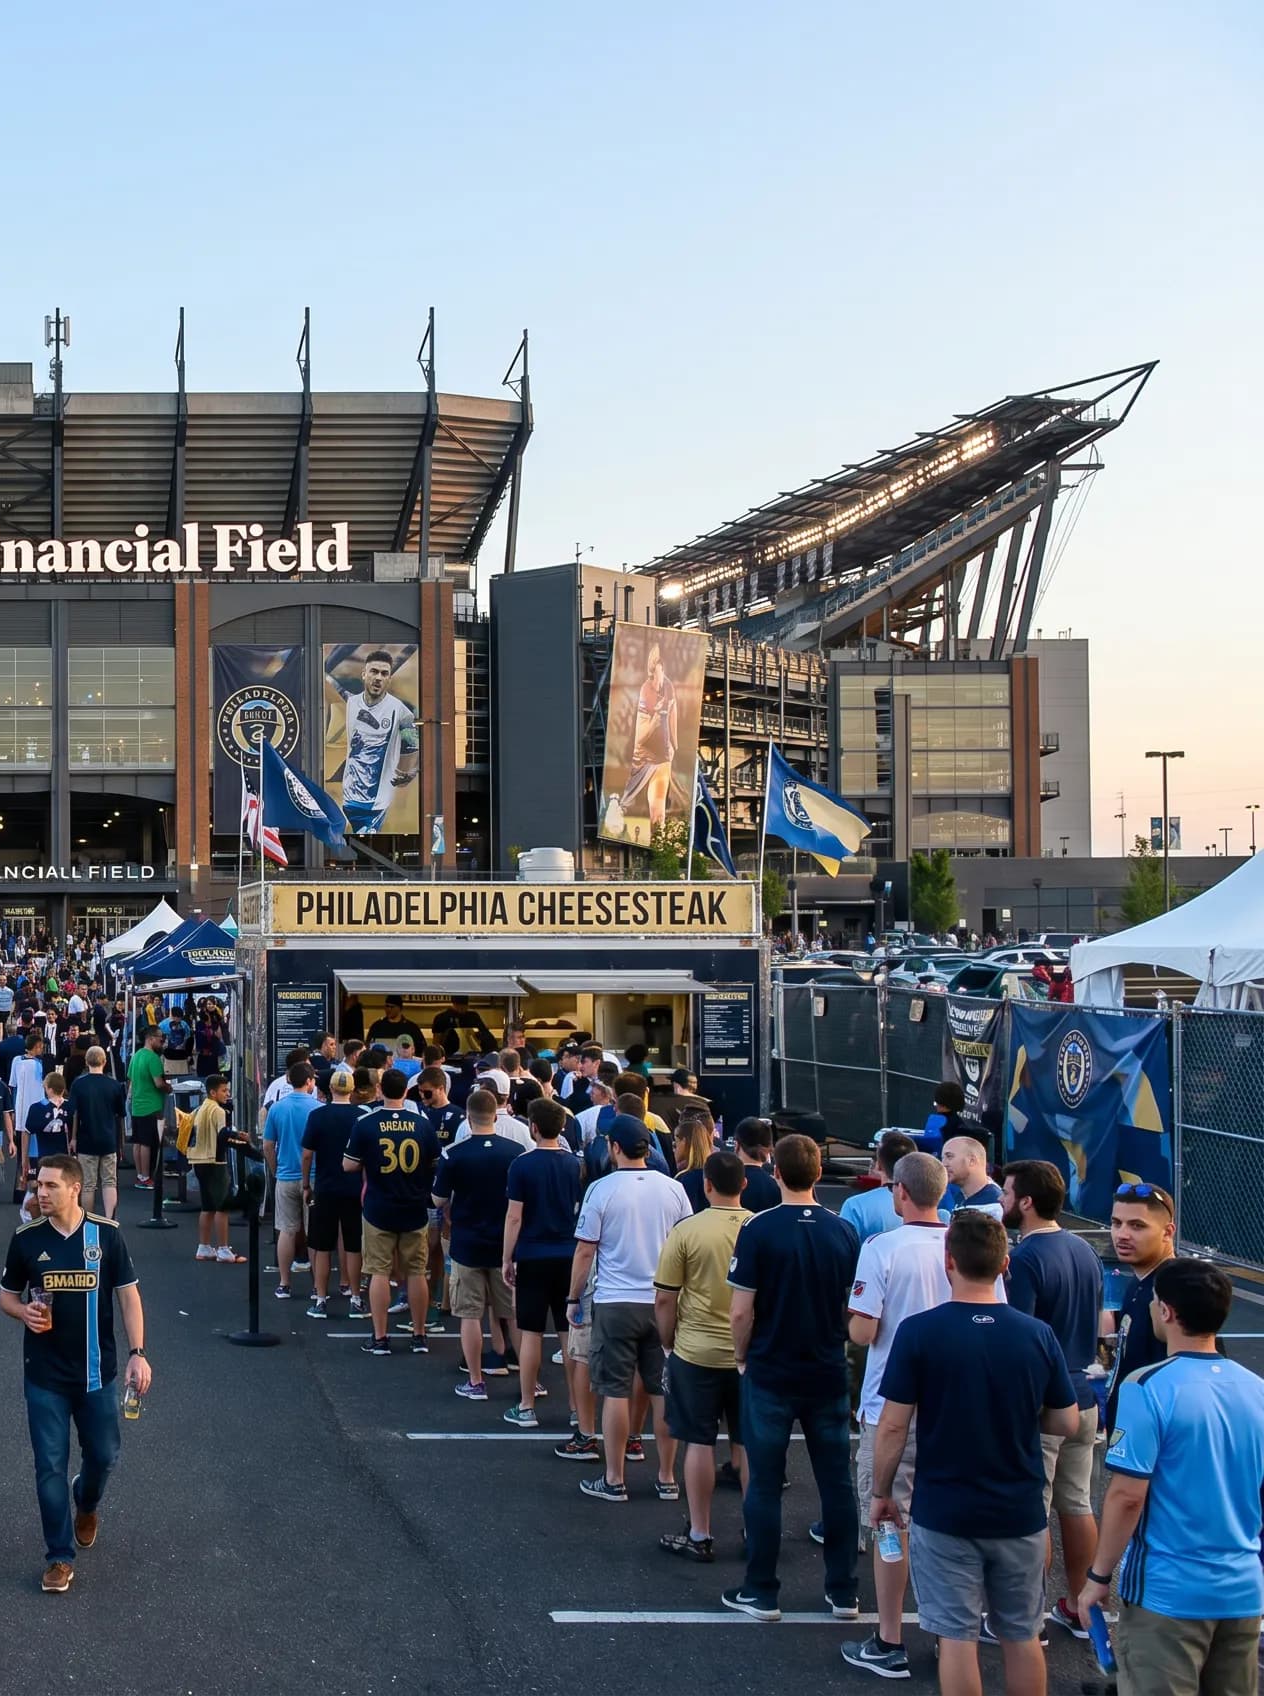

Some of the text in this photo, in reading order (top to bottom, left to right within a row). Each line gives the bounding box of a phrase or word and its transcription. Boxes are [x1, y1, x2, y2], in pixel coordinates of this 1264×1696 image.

[212, 522, 353, 572] Field
[88, 865, 155, 880] FIELD
[297, 891, 509, 925] PHILADELPHIA
[518, 891, 727, 926] CHEESESTEAK
[379, 1138, 420, 1174] 30
